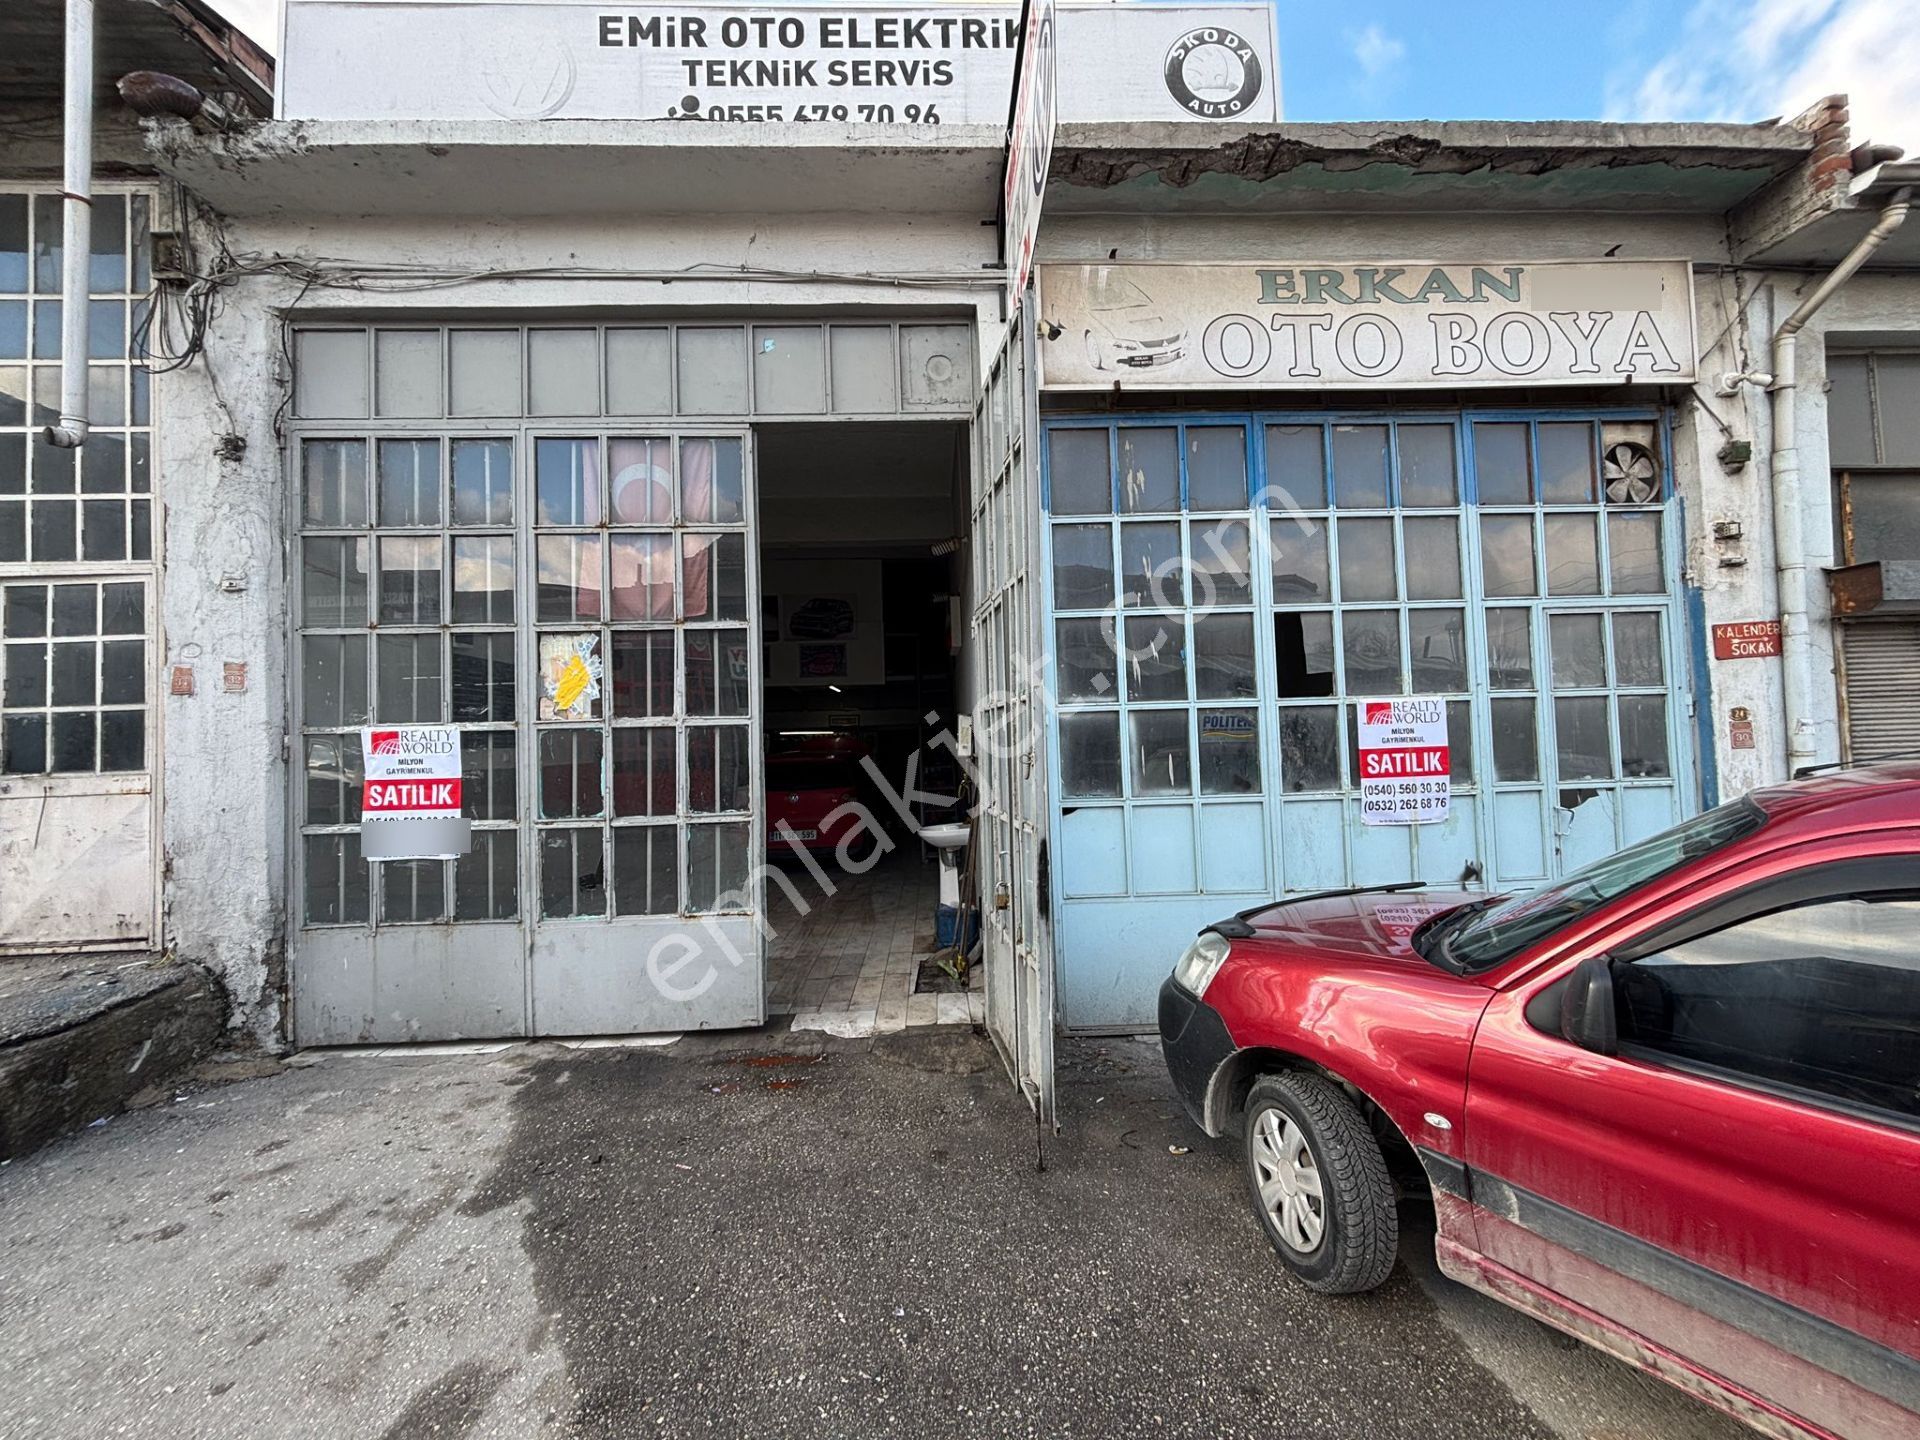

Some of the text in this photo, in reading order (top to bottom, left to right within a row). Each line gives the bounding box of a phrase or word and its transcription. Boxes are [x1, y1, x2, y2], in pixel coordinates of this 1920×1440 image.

[721, 17, 804, 48] OTO
[1171, 29, 1253, 63] SKODA
[1188, 100, 1241, 115] AUTO
[1255, 267, 1525, 305] ERKAN
[1202, 311, 1681, 378] OTO BOYA
[1716, 623, 1781, 638] KALENDER
[1731, 642, 1775, 656] SOKAK
[1393, 701, 1439, 712] REALTY
[1391, 711, 1441, 725] WORLD
[401, 730, 452, 742] REALTY
[1736, 732, 1749, 742] 30
[400, 741, 454, 755] WORLD
[1366, 752, 1443, 775] SATILIK
[369, 784, 454, 807] SATILIK
[1364, 782, 1447, 798] (0540) 560 30 30
[1364, 800, 1397, 814] (0532)
[1399, 799, 1419, 811] 262
[1435, 797, 1447, 809] 76
